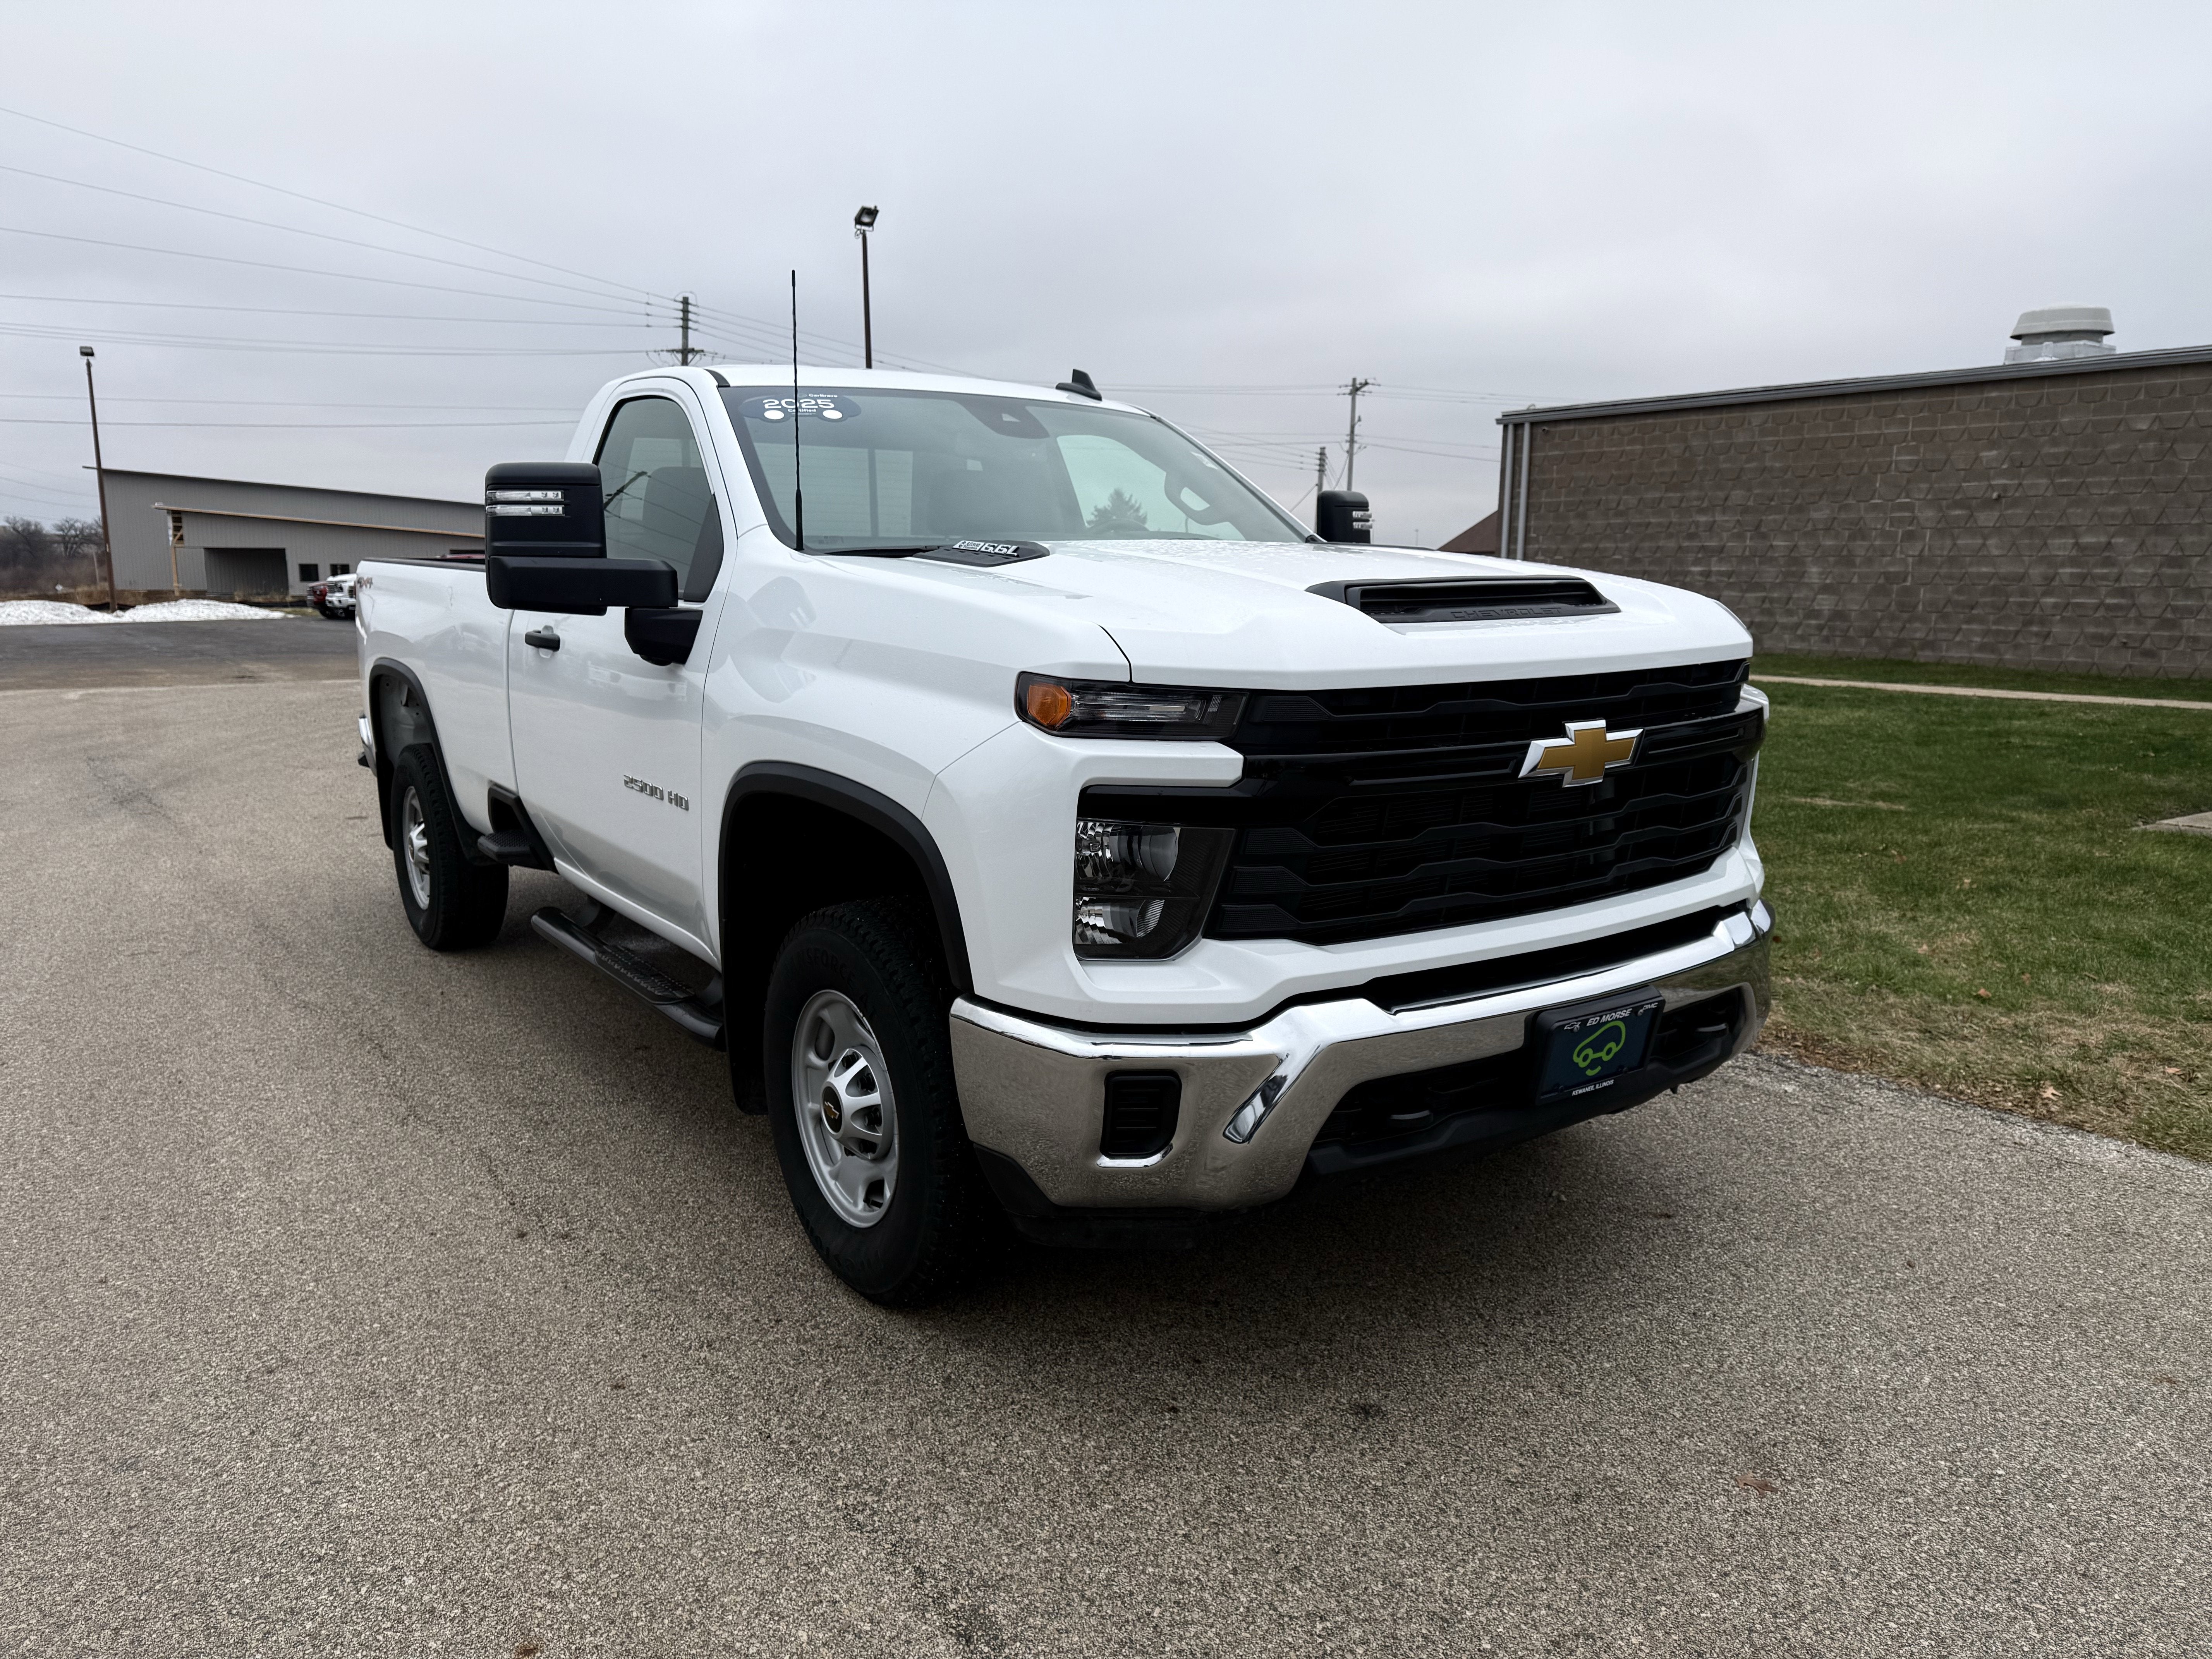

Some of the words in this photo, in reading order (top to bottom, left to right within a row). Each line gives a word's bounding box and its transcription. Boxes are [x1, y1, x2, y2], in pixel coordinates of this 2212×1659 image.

[763, 399, 835, 409] 2025
[981, 543, 1018, 557] 6.6L
[1450, 607, 1561, 618] CHEVROLET
[623, 774, 664, 801] 2500
[667, 789, 689, 811] HD
[1586, 1017, 1600, 1027] ED
[1600, 1008, 1633, 1023] MORSE
[1595, 1079, 1614, 1089] ILLINOIS
